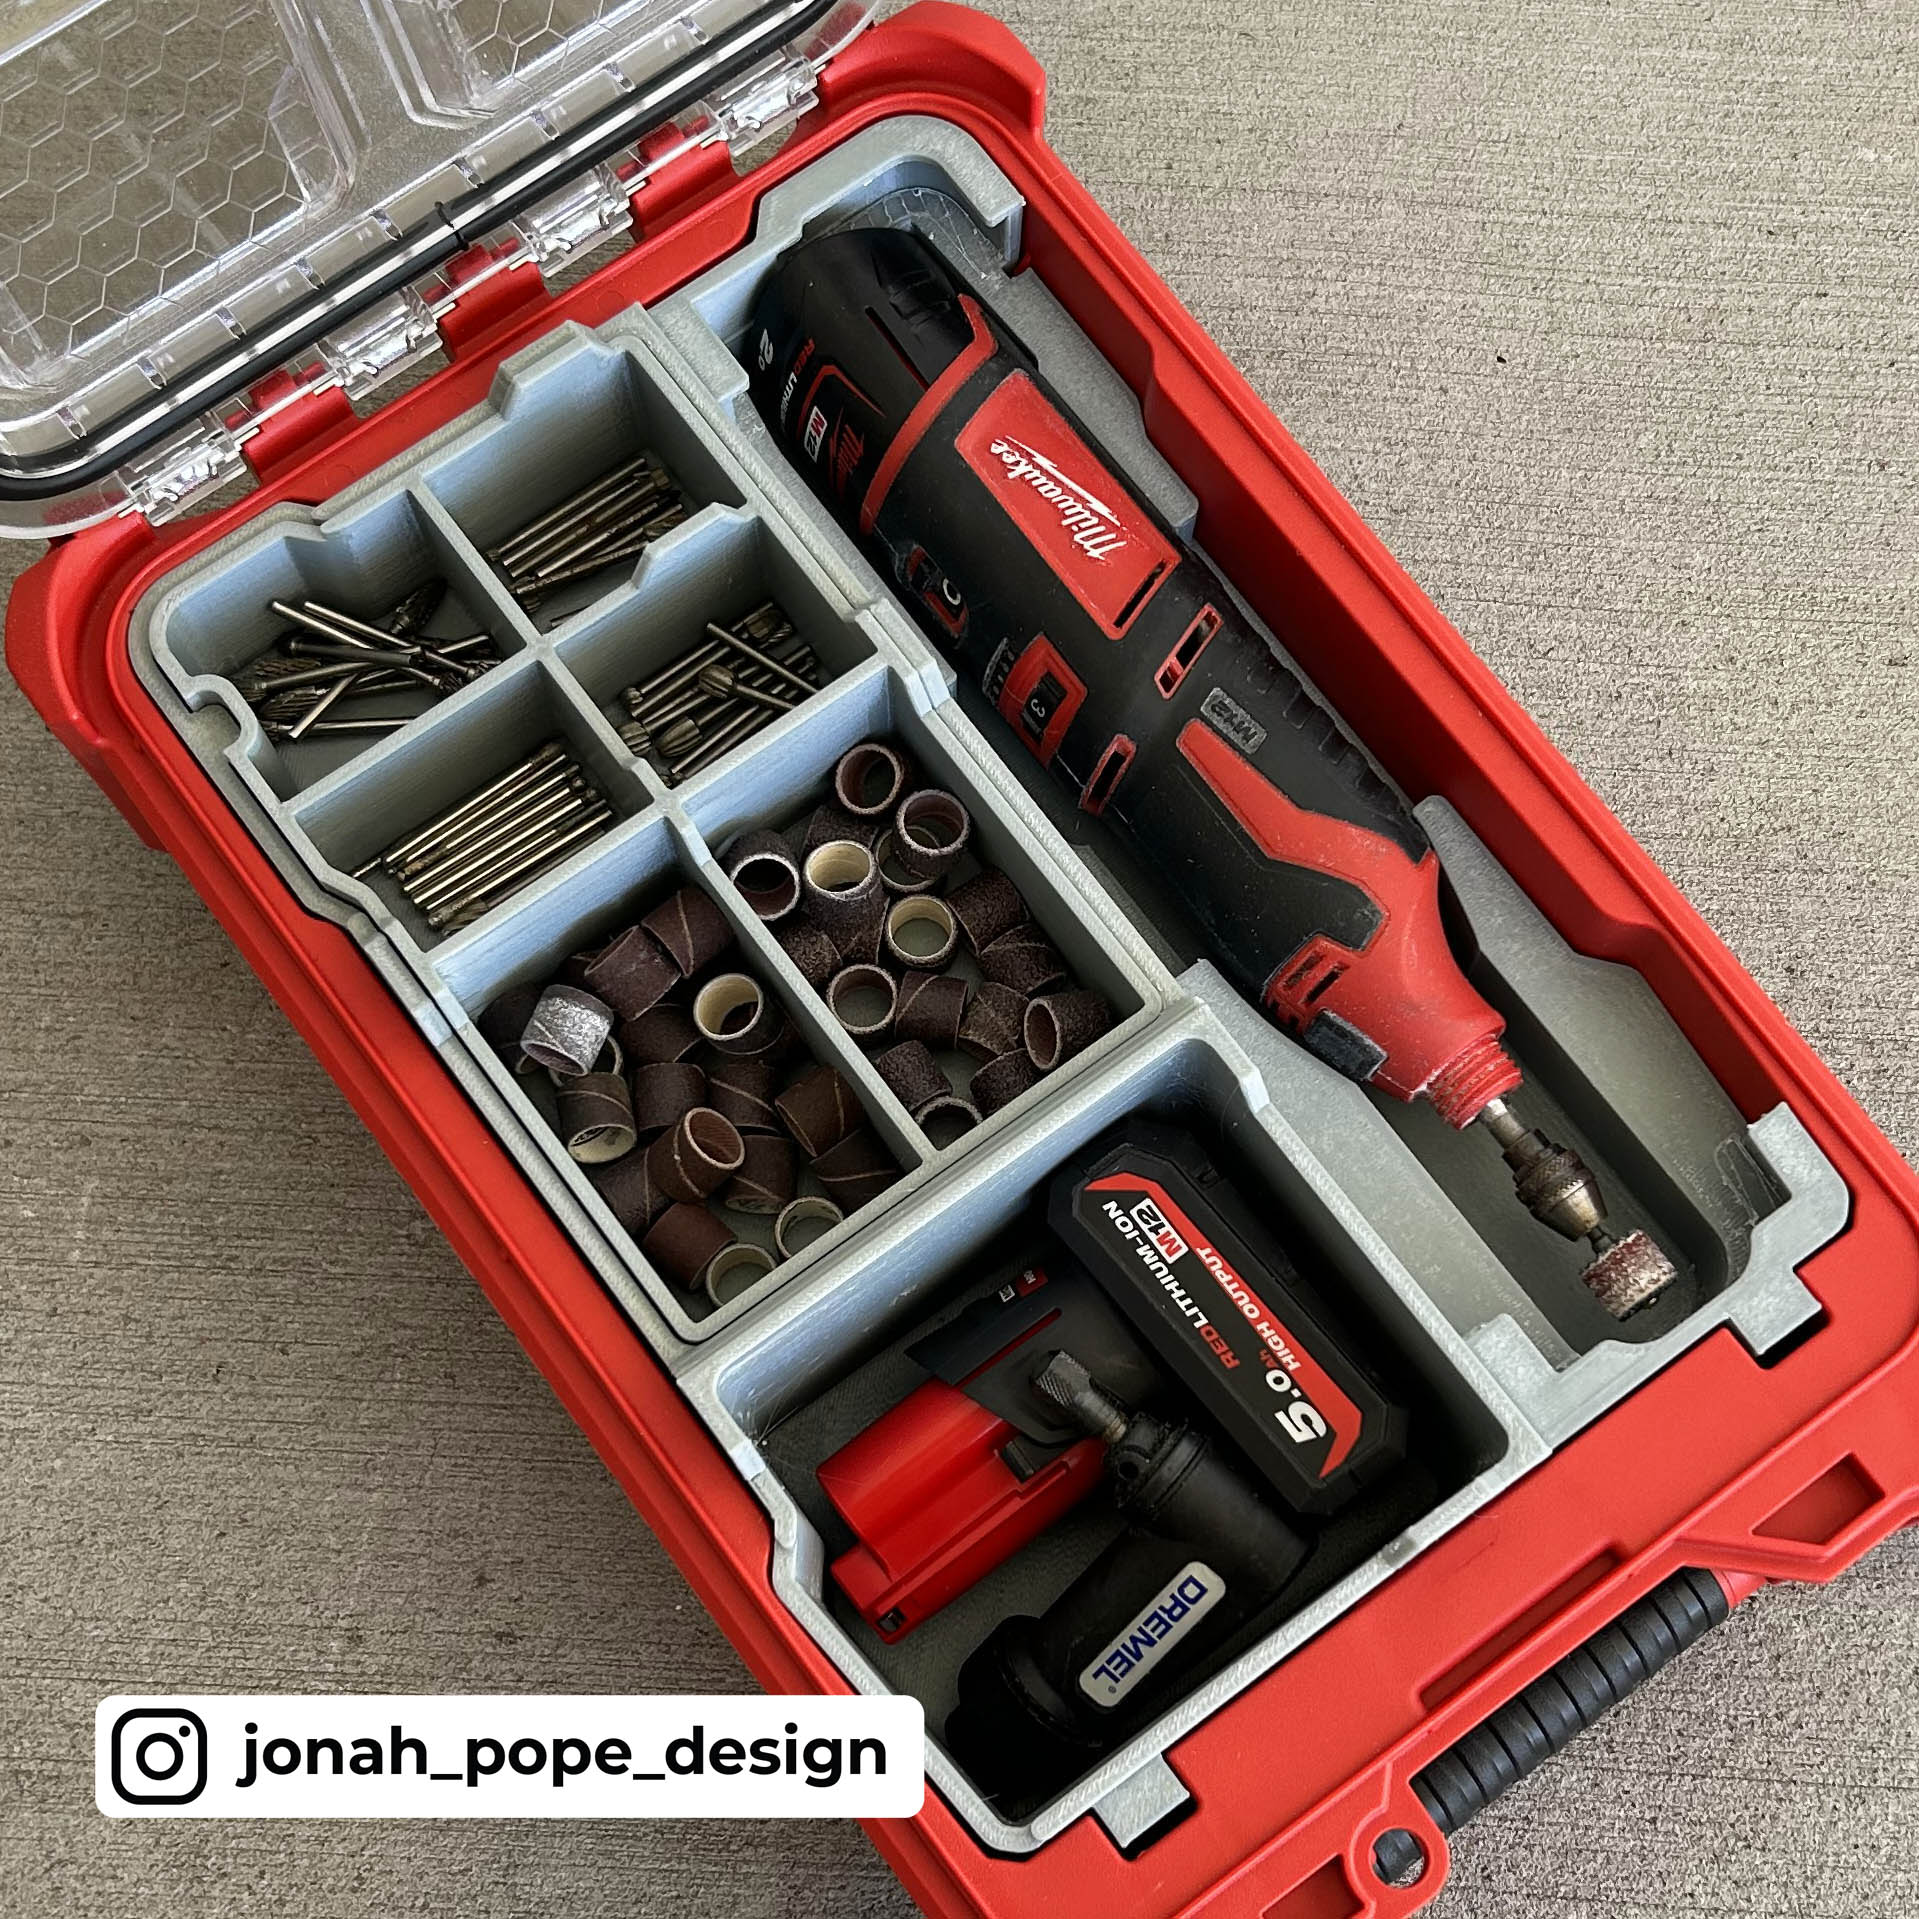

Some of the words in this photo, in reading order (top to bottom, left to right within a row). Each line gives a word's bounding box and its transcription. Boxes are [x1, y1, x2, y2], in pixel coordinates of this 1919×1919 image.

[990, 434, 1127, 561] Milwaukee
[1136, 1204, 1183, 1258] M12
[1102, 1200, 1240, 1370] REDLITHIUM-ION
[1196, 1246, 1260, 1320] OUTPUT
[1256, 1321, 1301, 1371] HIGH
[1092, 1574, 1208, 1684] DREMEL
